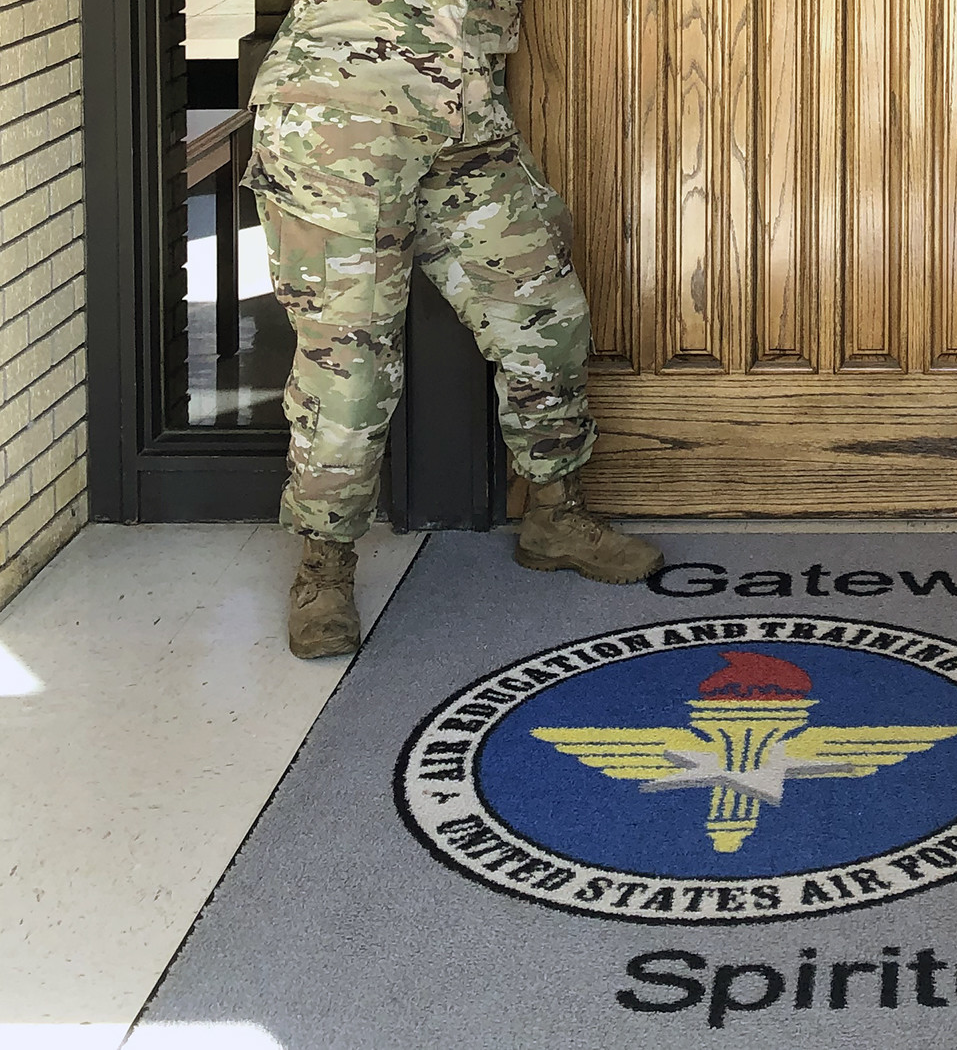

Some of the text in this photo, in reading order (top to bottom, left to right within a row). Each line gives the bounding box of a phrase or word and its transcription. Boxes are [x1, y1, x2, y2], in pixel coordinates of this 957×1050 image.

[663, 623, 748, 646] AND
[437, 634, 653, 733] EDUCATION
[418, 740, 472, 782] AIR
[436, 813, 577, 892] UNITED
[574, 876, 782, 913] STATES
[800, 867, 892, 906] AIR
